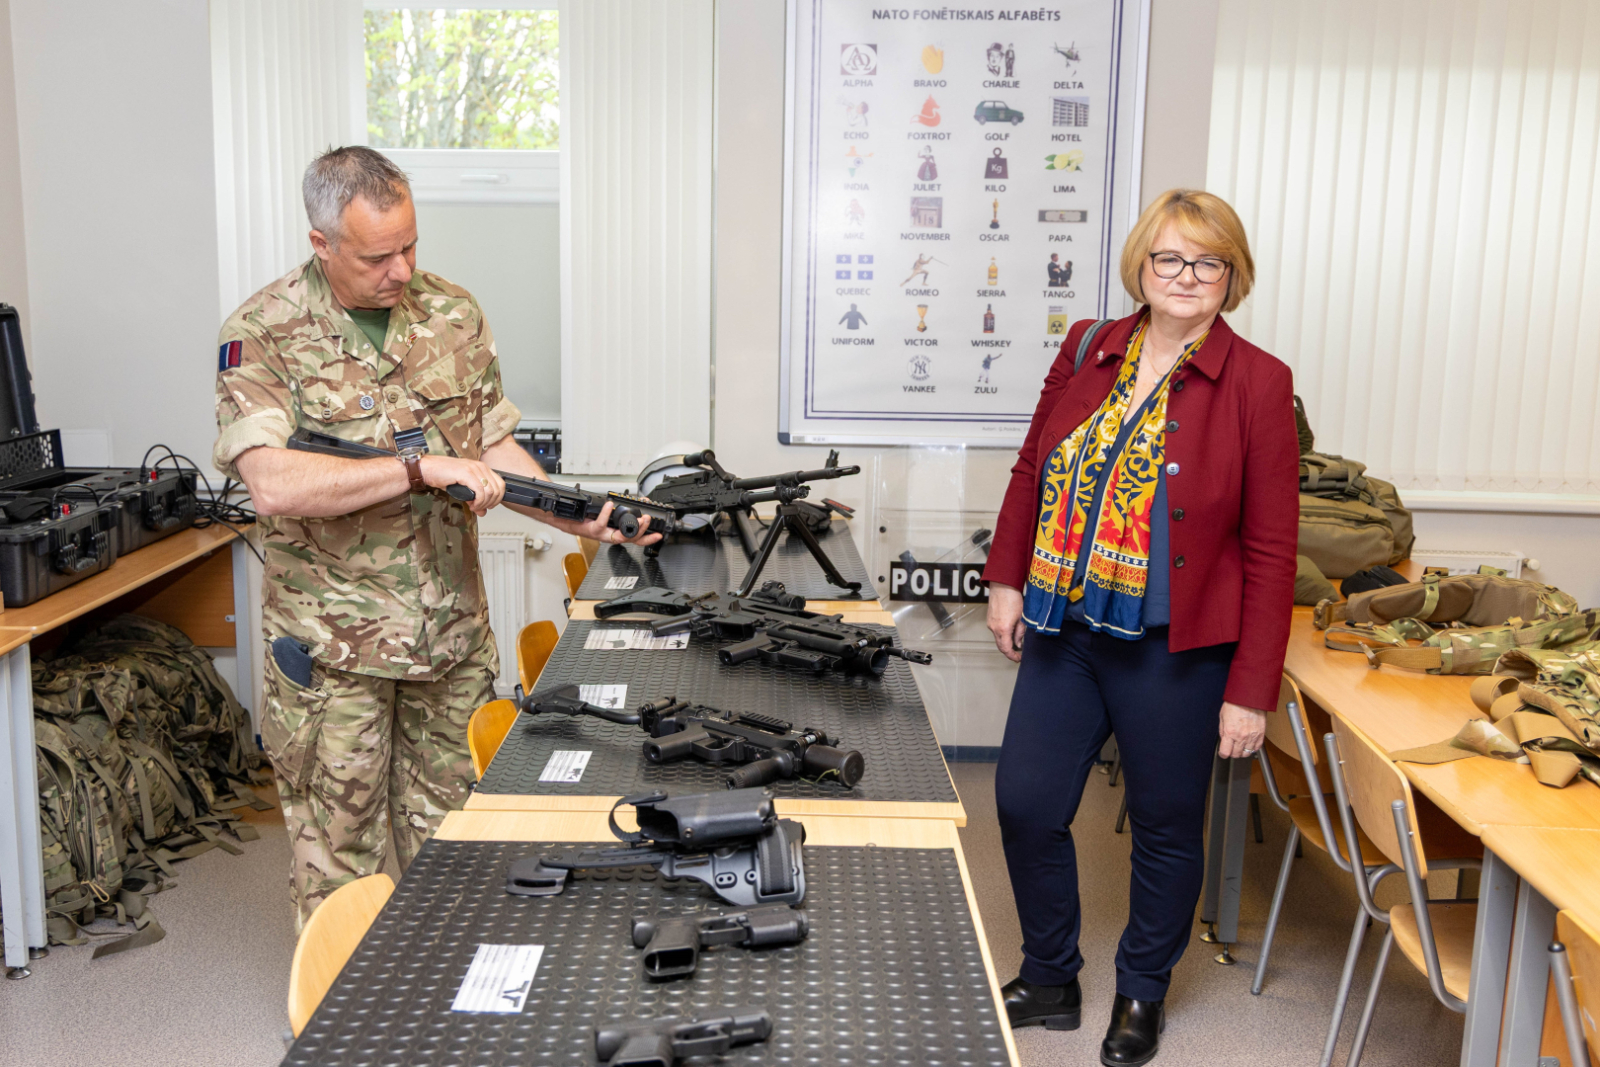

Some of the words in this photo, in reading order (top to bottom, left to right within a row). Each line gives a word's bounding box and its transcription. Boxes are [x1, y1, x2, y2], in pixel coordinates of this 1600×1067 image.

[872, 10, 909, 20] NATO
[914, 7, 994, 20] FONĒTISKAIS
[998, 8, 1060, 21] ALFABĒTS
[843, 79, 873, 87] ALPHA
[983, 80, 1020, 88] CHARLIE
[1054, 81, 1084, 89] DELTA
[844, 131, 869, 140] ECHO
[908, 132, 951, 140] FOXTROT
[985, 133, 1009, 141] GOLF
[1052, 134, 1081, 142] HOTEL
[991, 164, 1002, 173] Kg
[844, 183, 870, 191] INDIA
[913, 183, 941, 191] JULIET
[901, 233, 950, 241] NOVEMBER
[836, 288, 871, 296] QUEBEC
[1043, 290, 1075, 298] TANGO
[974, 386, 997, 394] ZULU
[892, 568, 989, 597] POLIC
